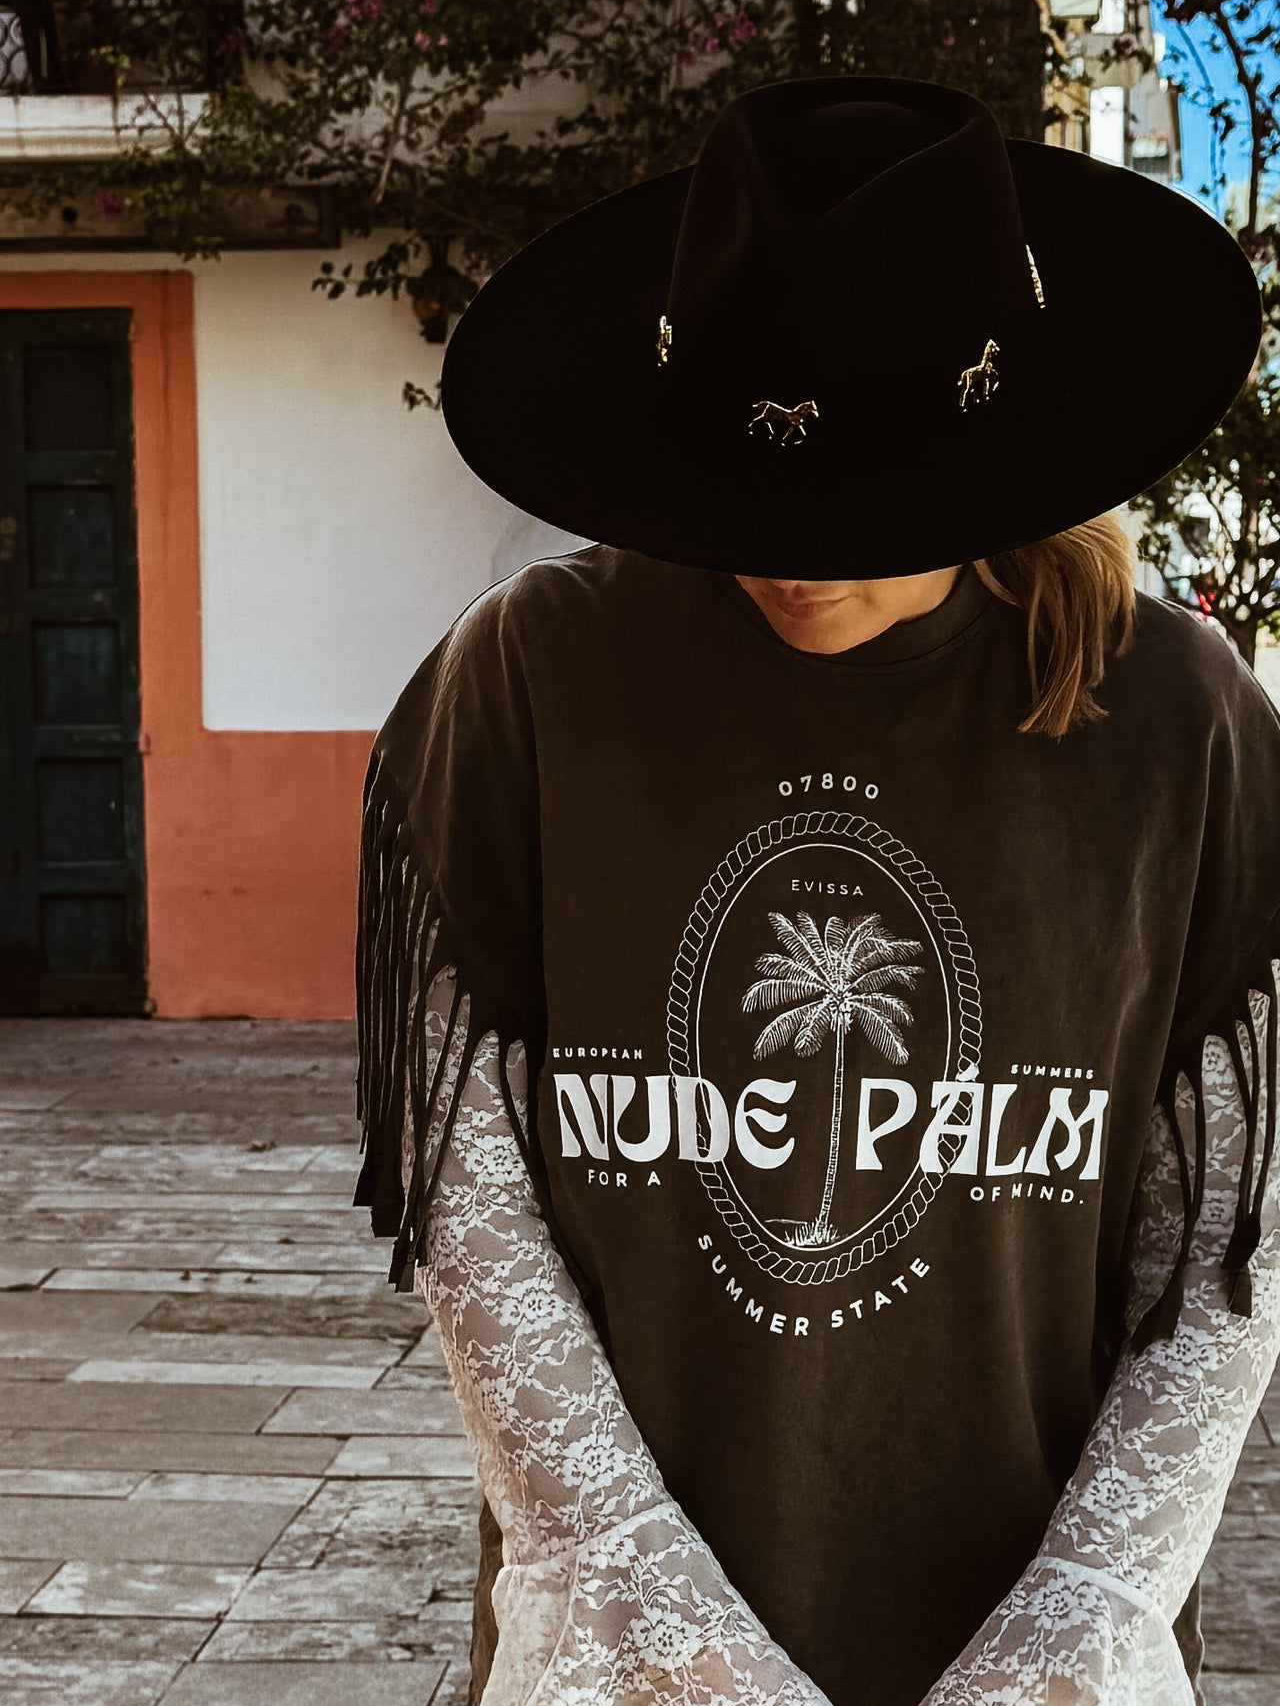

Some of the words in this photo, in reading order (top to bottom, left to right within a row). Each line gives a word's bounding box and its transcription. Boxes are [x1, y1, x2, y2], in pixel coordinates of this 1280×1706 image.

[778, 772, 879, 800] 07800
[791, 879, 864, 896] EVISSA
[552, 1047, 644, 1061] EUROPEAN
[1010, 1063, 1095, 1080] SUMMERS
[553, 1073, 798, 1170] NUDE
[855, 1077, 1110, 1181] PALM
[587, 1169, 628, 1188] FOR
[646, 1170, 662, 1187] A
[969, 1186, 1002, 1203] OF
[697, 1234, 810, 1337] SUMMER
[830, 1257, 931, 1329] STATE
